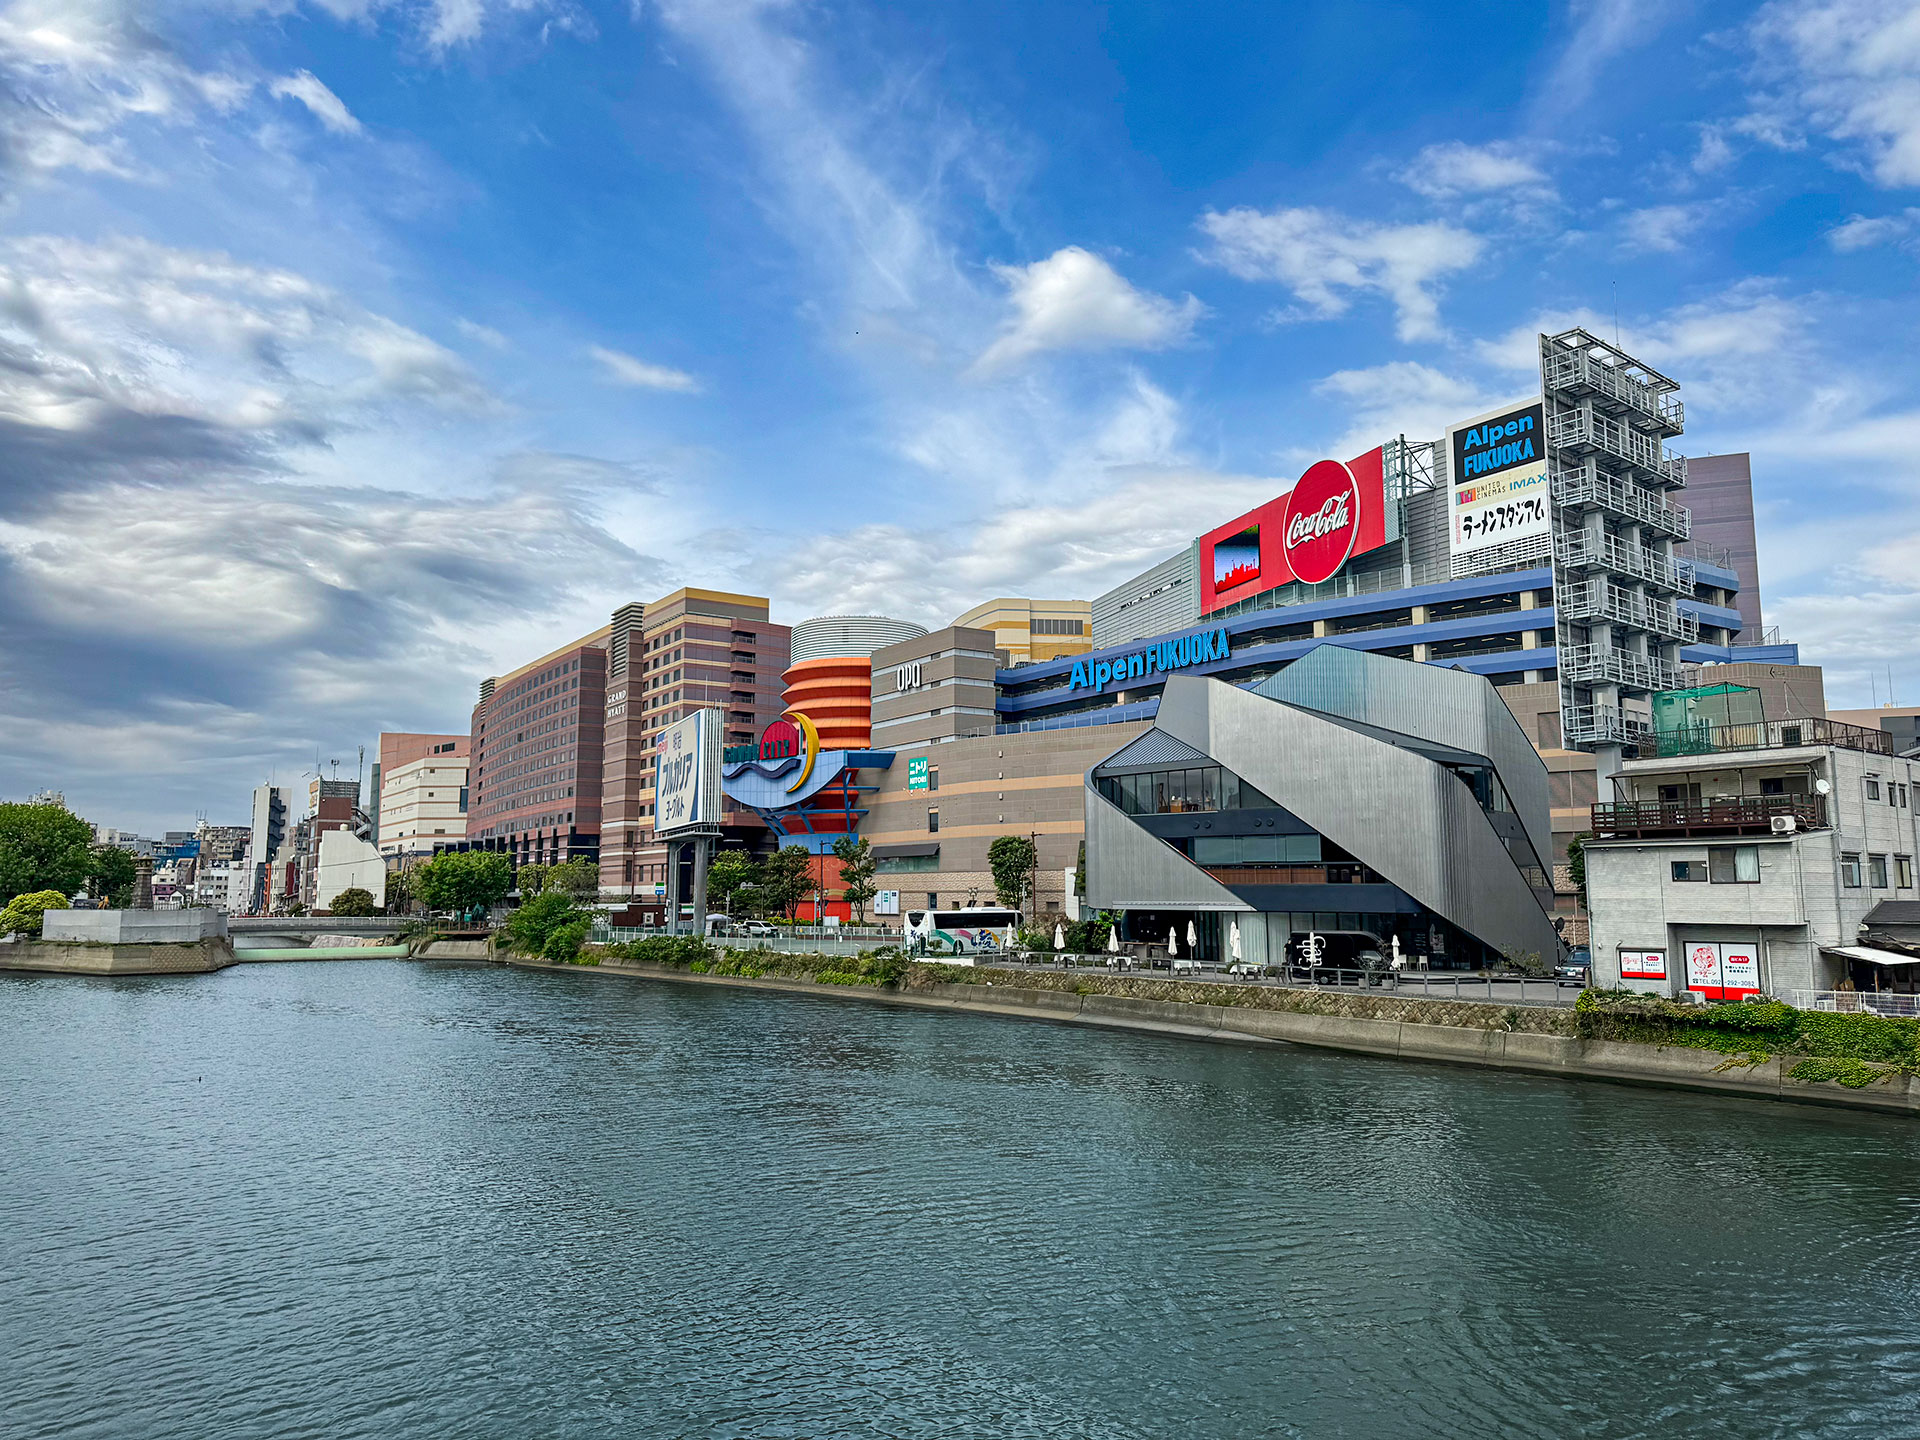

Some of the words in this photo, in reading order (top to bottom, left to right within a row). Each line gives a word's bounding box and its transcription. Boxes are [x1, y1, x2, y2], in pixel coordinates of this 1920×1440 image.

[1464, 415, 1534, 450] Alpen
[1464, 437, 1535, 477] FUKUOKA
[1476, 480, 1501, 493] UNITED
[1476, 486, 1506, 500] CINEMAS
[1509, 473, 1547, 491] IMAX
[1286, 488, 1352, 549] Coca-Cola
[1463, 498, 1545, 540] ラーメンスタジアム
[1069, 653, 1144, 692] Alpen
[1145, 628, 1230, 674] FUKUOKA
[607, 690, 627, 704] GRAND
[607, 704, 626, 718] HYATT
[763, 739, 790, 758] CITY
[661, 752, 693, 797] ブルガリア
[909, 760, 927, 775] ニトリ
[665, 794, 685, 821] ヨーグルト
